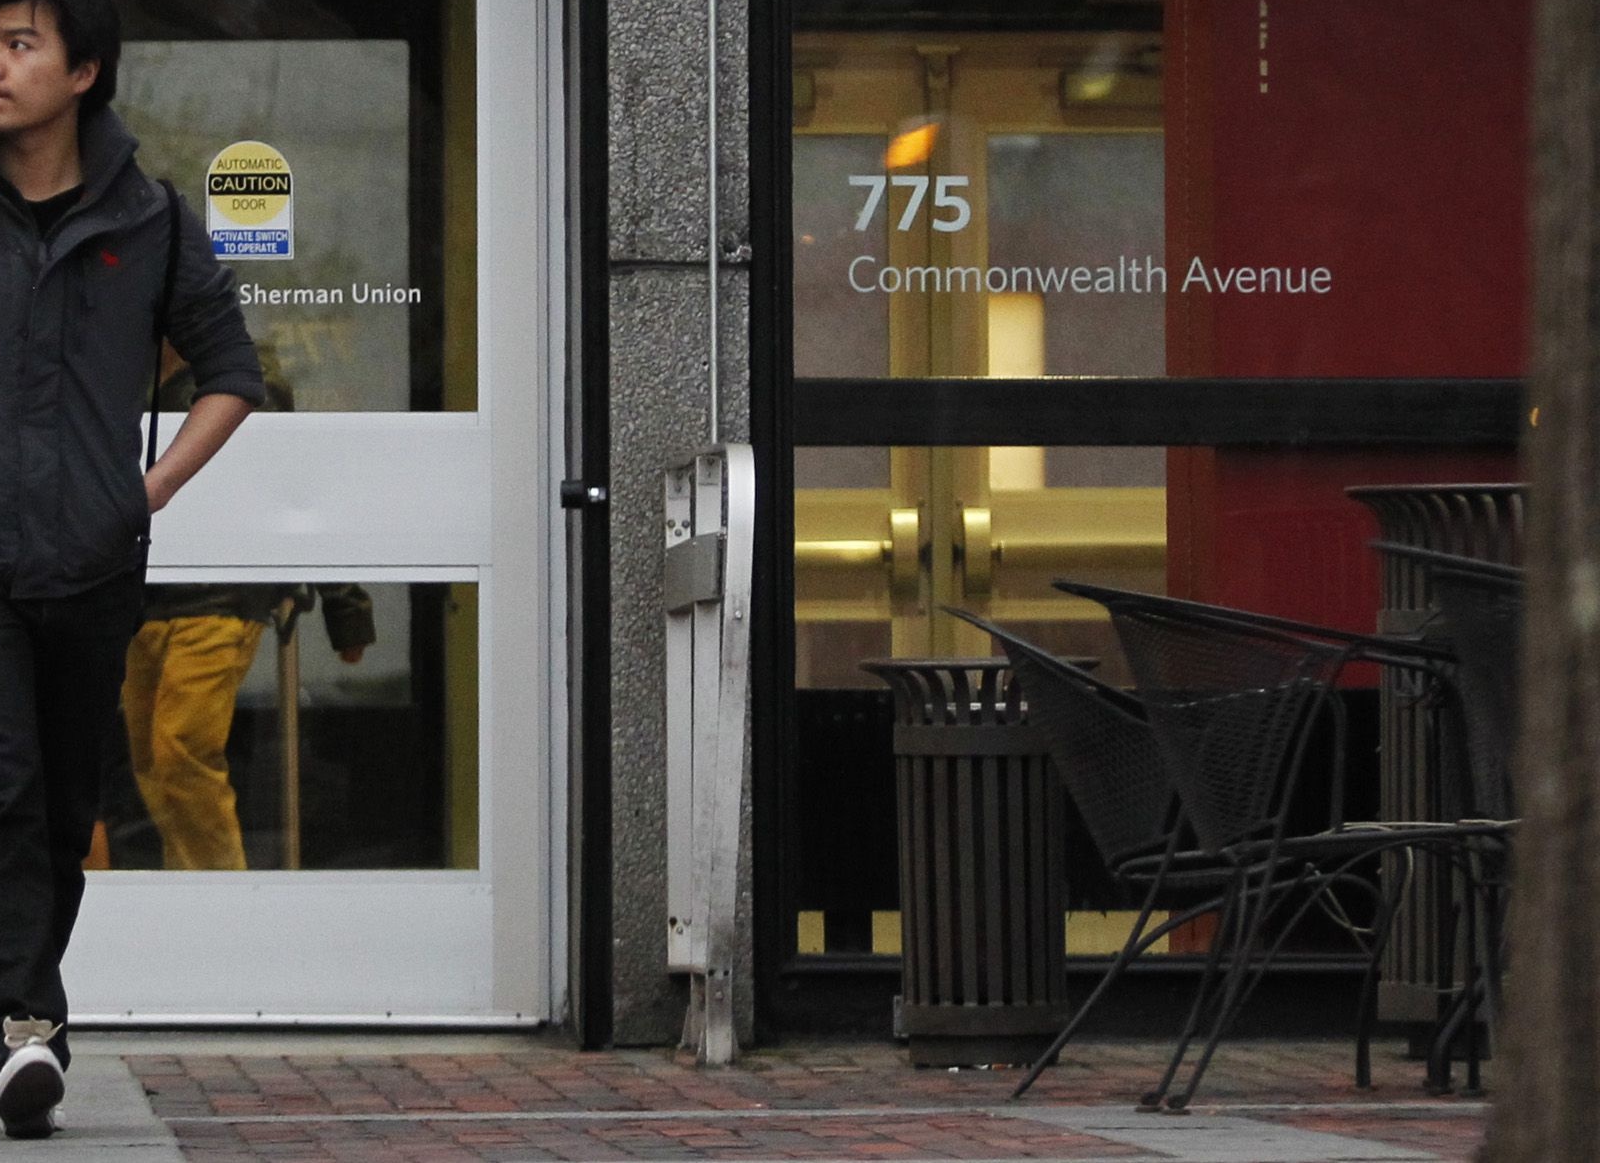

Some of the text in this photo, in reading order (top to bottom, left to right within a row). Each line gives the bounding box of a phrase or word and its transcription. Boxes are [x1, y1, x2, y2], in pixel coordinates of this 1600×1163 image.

[216, 158, 283, 170] AUTOMATIC
[210, 176, 289, 191] CAUTION
[232, 198, 267, 211] DOOR
[848, 175, 972, 232] 775
[213, 231, 288, 242] ACTIVATE SWITCH
[224, 243, 278, 254] TO OPERATE
[848, 256, 1332, 293] Commonwealth Avenue
[239, 282, 421, 304] Sherman Union
